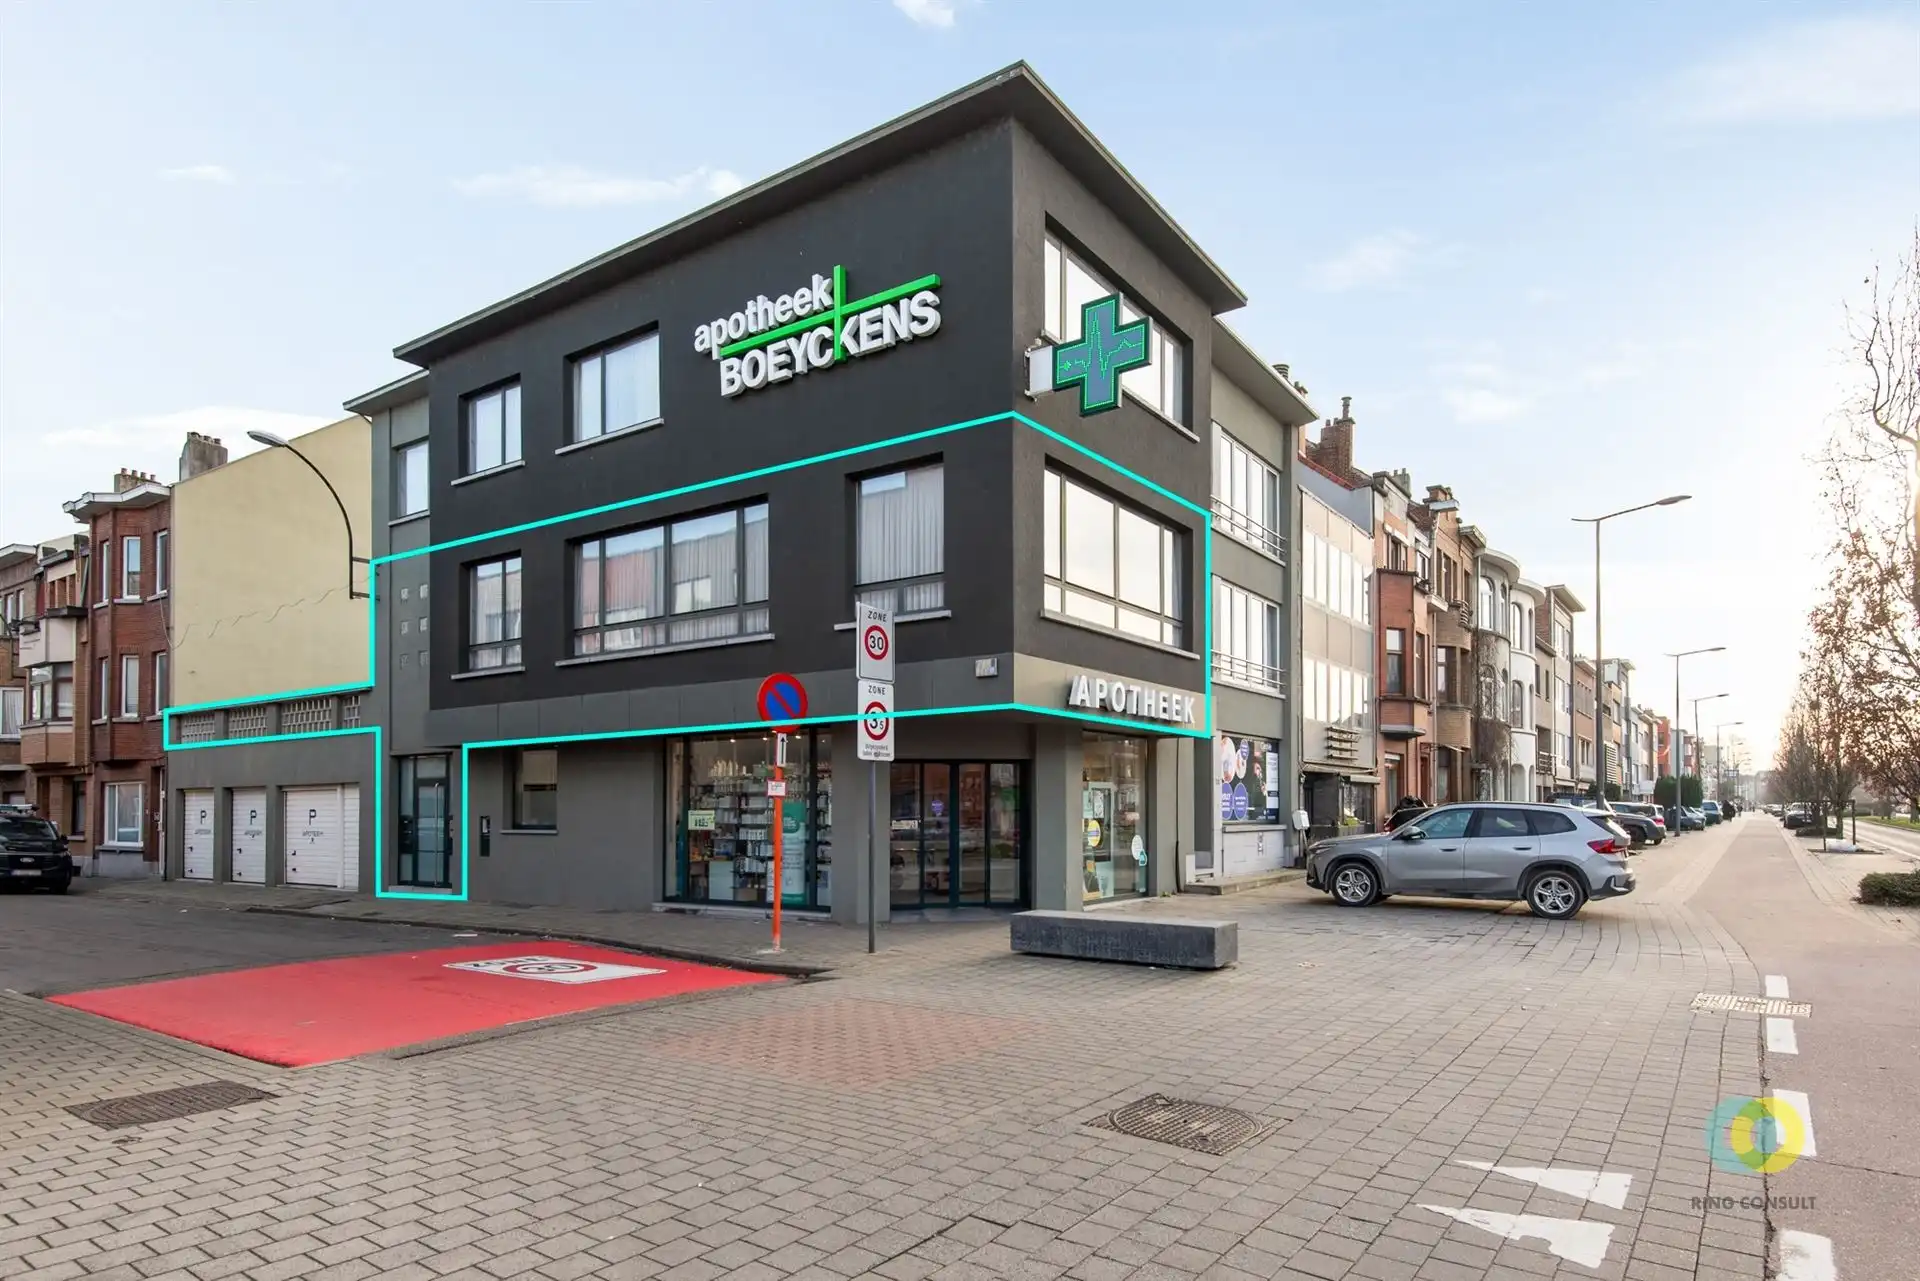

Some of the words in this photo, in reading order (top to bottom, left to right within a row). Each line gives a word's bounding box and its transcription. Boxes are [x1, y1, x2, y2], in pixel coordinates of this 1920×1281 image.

[693, 273, 834, 361] apotheek
[719, 290, 941, 398] BOEYCKENS
[867, 610, 888, 622] ZONE
[869, 634, 884, 650] 30
[868, 684, 886, 695] ZONE
[1068, 675, 1196, 724] APOTHEEK
[250, 810, 258, 825] P
[309, 809, 317, 826] P
